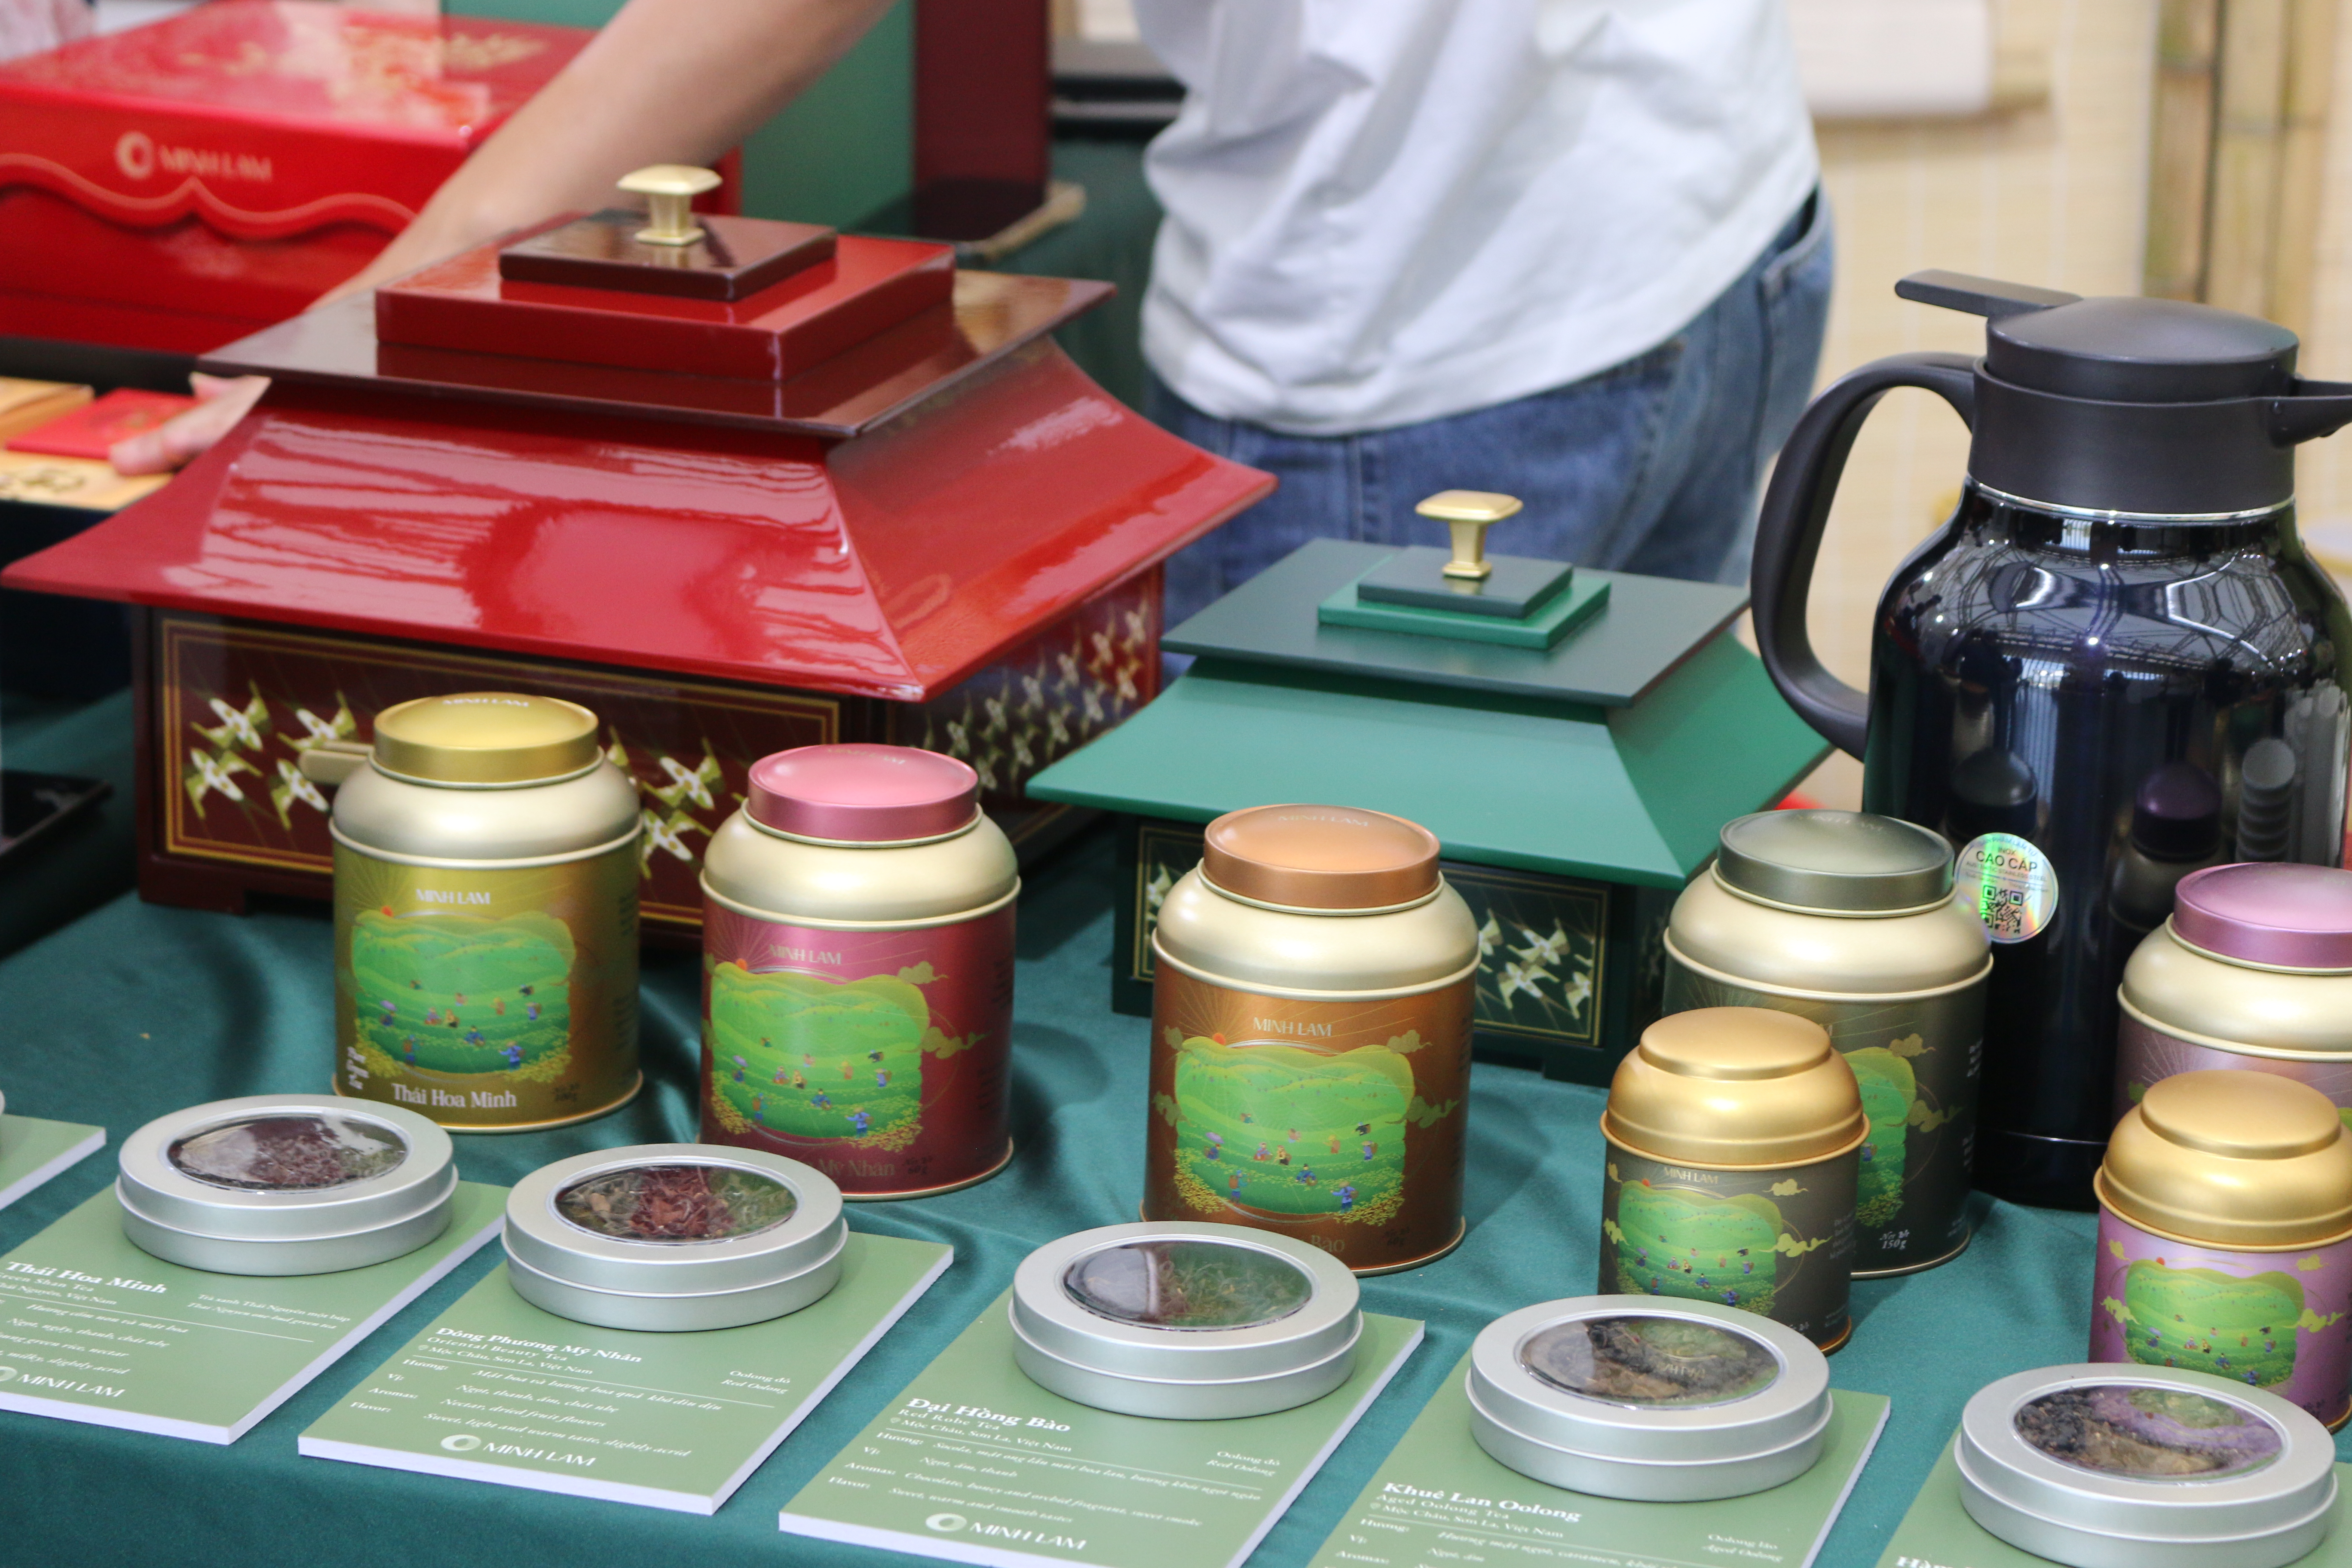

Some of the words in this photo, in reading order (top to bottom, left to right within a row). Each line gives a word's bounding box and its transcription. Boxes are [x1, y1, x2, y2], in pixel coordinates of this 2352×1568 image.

[1976, 850, 2005, 866] CAO
[415, 888, 454, 903] MINH
[457, 891, 490, 905] LAM
[769, 944, 805, 962] MINH
[809, 950, 842, 965] LAM
[1253, 1017, 1294, 1034] MINH
[1298, 1022, 1332, 1037] LAM
[431, 1088, 466, 1108] Hoa
[470, 1090, 517, 1108] Minh
[1664, 1166, 1691, 1181] MINH
[1694, 1172, 1719, 1185] LAM
[1882, 1239, 1907, 1250] 150g
[6, 1261, 57, 1276] Thái
[57, 1270, 103, 1283] Hoa
[105, 1277, 167, 1293] Minh
[34, 1278, 67, 1288] Shan
[72, 1284, 94, 1292] Tea
[89, 1296, 117, 1305] Nam
[22, 1338, 60, 1347] green
[89, 1348, 129, 1357] nectar
[427, 1337, 488, 1350] Oriental
[490, 1345, 539, 1358] Beauty
[545, 1353, 567, 1361] Tea
[435, 1328, 486, 1342] Đông
[487, 1335, 558, 1352] Phương
[560, 1345, 591, 1356] Mỹ
[592, 1350, 642, 1362] Nhân
[46, 1358, 94, 1370] slightly
[428, 1347, 456, 1355] Mộc
[456, 1351, 490, 1360] Châu,
[540, 1362, 563, 1370] Việt
[564, 1366, 593, 1374] Nam
[17, 1374, 77, 1389] MINH
[75, 1383, 126, 1397] LAM
[402, 1359, 449, 1371] Hương:
[471, 1370, 503, 1378] Mật
[503, 1374, 528, 1382] hoa
[548, 1380, 590, 1392] hương
[590, 1386, 615, 1395] hoa
[729, 1371, 773, 1382] Oolong
[456, 1384, 490, 1394] Ngọt,
[493, 1390, 533, 1401] thanh,
[564, 1400, 594, 1409] chát
[594, 1405, 619, 1413] nhẹ
[747, 1383, 789, 1394] Oolong
[368, 1387, 418, 1399] Aromas:
[440, 1399, 486, 1410] Nectar,
[488, 1406, 528, 1415] dried
[521, 1411, 560, 1420] fruit
[555, 1416, 606, 1427] flowers
[906, 1398, 952, 1412] Đại
[953, 1406, 1023, 1426] Hồng
[1025, 1417, 1071, 1431] Bào
[350, 1402, 392, 1412] Flavor:
[423, 1413, 462, 1424] Sweet,
[465, 1418, 498, 1428] light
[527, 1429, 566, 1438] warm
[568, 1435, 600, 1444] taste,
[603, 1439, 652, 1452] slightly
[652, 1448, 692, 1457] acrid
[898, 1409, 928, 1418] Red
[931, 1414, 970, 1425] Robe
[977, 1421, 1000, 1430] Tea
[901, 1420, 928, 1428] Mộc
[968, 1430, 991, 1439] Sơn
[1017, 1438, 1040, 1447] Việt
[1042, 1442, 1072, 1452] Nam
[483, 1442, 544, 1458] MINH
[545, 1452, 596, 1466] LAM
[1216, 1451, 1262, 1464] Oolong
[1383, 1482, 1444, 1500] Khuê
[1449, 1492, 1491, 1507] Lan
[1498, 1500, 1583, 1523] Oolong
[1486, 1510, 1509, 1519] Tea
[969, 1522, 1032, 1540] MINH
[1035, 1533, 1087, 1550] LAM
